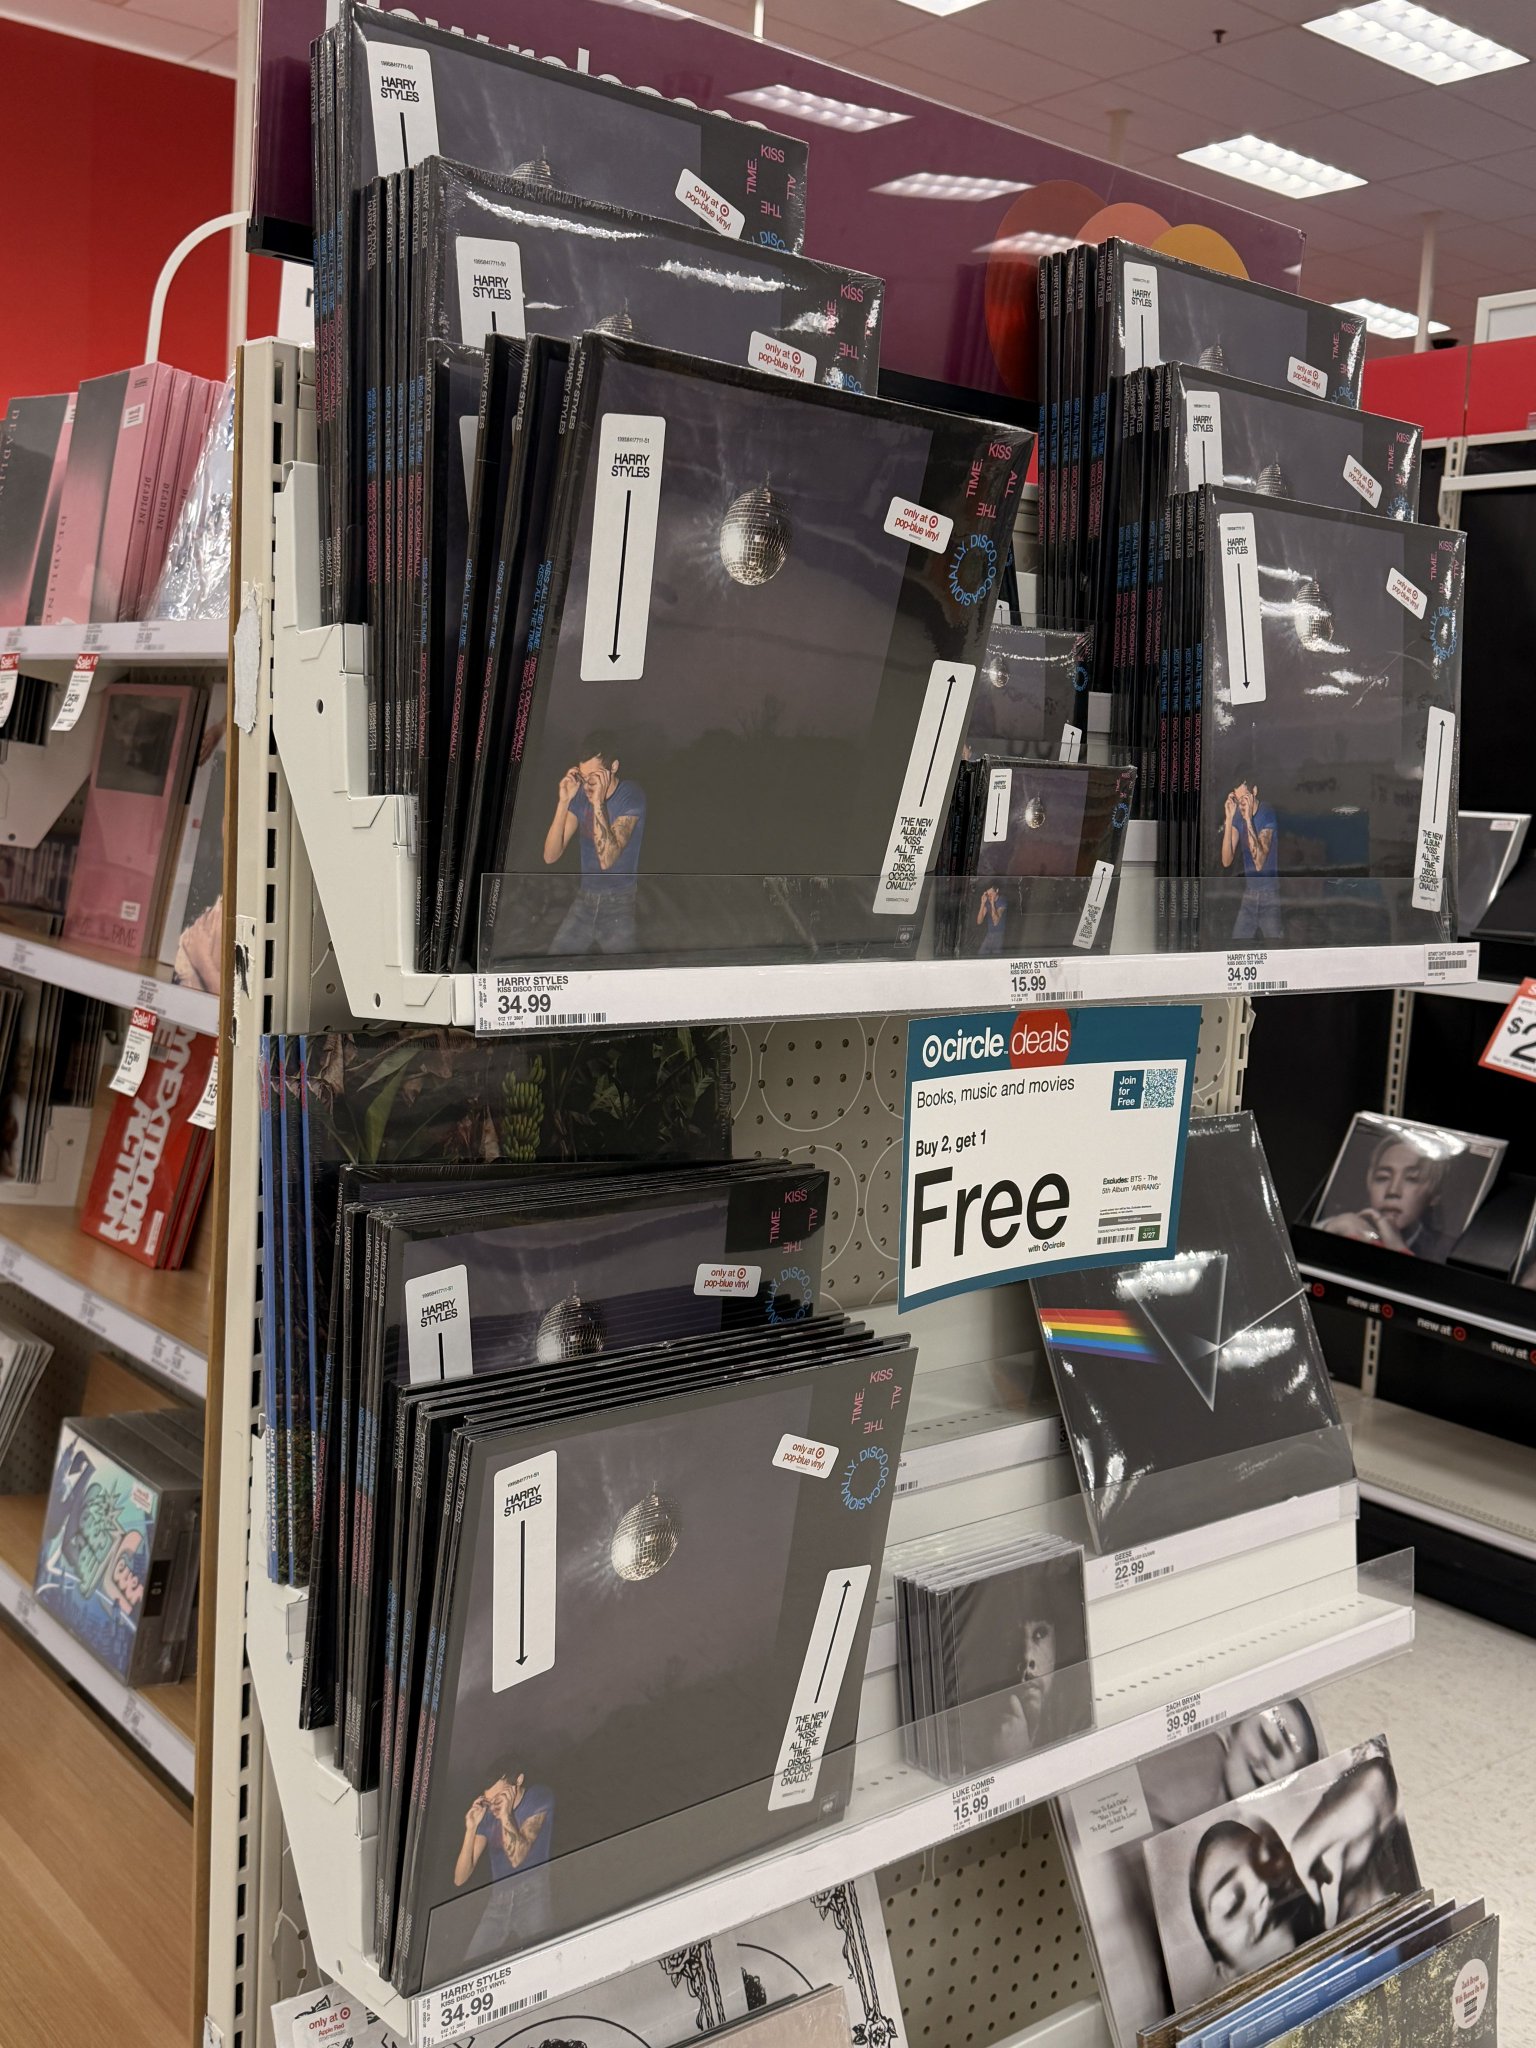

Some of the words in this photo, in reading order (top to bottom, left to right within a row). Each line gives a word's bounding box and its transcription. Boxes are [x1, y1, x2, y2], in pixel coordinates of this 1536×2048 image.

[381, 75, 416, 91] HARRY
[380, 88, 420, 102] STYLES
[760, 144, 784, 164] KISS
[746, 158, 758, 194] TIME.
[786, 174, 796, 200] ALL
[694, 184, 711, 203] only
[711, 198, 720, 209] at
[685, 190, 715, 218] pop-blue
[716, 214, 732, 230] vinyl
[760, 200, 782, 219] THE
[474, 274, 508, 288] HARRY
[472, 286, 512, 300] STYLES
[840, 284, 864, 302] KISS
[1132, 288, 1152, 298] HARRY
[1132, 296, 1152, 308] STYLES
[1340, 321, 1356, 334] KISS
[765, 342, 782, 356] only
[782, 350, 790, 359] at
[839, 342, 860, 360] THE
[483, 354, 491, 389] HARRY
[576, 352, 586, 388] HARRY
[758, 352, 789, 370] pop-blue
[790, 364, 805, 378] vinyl
[479, 390, 488, 429] STYLES
[568, 390, 580, 430] STYLES
[1192, 424, 1214, 433] STYLES
[1193, 415, 1212, 426] HARRY
[614, 453, 650, 466] HARRY
[988, 442, 1013, 460] KISS
[611, 465, 650, 478] STYLES
[966, 458, 984, 498] TIME.
[1004, 470, 1018, 498] ALL
[138, 476, 153, 526] DEADLINE
[156, 482, 170, 531] DEADLINE
[904, 506, 920, 522] only
[920, 514, 928, 524] at
[976, 502, 996, 519] THE
[894, 516, 924, 535] pop-blue
[924, 528, 940, 542] vinyl
[1226, 546, 1248, 556] STYLES
[1227, 538, 1247, 548] HARRY
[1438, 540, 1454, 552] KISS
[75, 655, 93, 670] Sale!
[900, 816, 915, 826] THE
[916, 818, 933, 828] NEW
[894, 845, 908, 854] ALL
[910, 846, 924, 854] THE
[1010, 962, 1032, 970] HARRY
[1034, 960, 1058, 969] STYLES
[1228, 966, 1257, 982] 34.99
[497, 977, 531, 986] HARRY
[534, 976, 568, 986] STYLES
[1012, 976, 1046, 992] 15.99
[498, 994, 552, 1014] 34.99
[132, 1010, 150, 1028] Sale!
[942, 1026, 1004, 1062] circle
[1011, 1022, 1070, 1056] deals
[1120, 1076, 1136, 1085] Join
[917, 1088, 957, 1108] Books,
[961, 1082, 998, 1102] music
[1001, 1079, 1026, 1096] and
[1028, 1076, 1075, 1094] movies
[1118, 1086, 1130, 1096] for
[1118, 1097, 1136, 1106] Free
[916, 1138, 938, 1158] Buy
[942, 1135, 952, 1154] 2,
[956, 1132, 976, 1152] get
[980, 1129, 986, 1145] 1
[1102, 1177, 1129, 1186] Excludes:
[784, 1188, 808, 1204] KISS
[770, 1207, 780, 1244] TIME.
[808, 1208, 818, 1232] ALL
[912, 1166, 1070, 1269] Free
[782, 1240, 804, 1254] THE
[1028, 1244, 1040, 1252] with
[1048, 1240, 1066, 1250] circle
[710, 1268, 726, 1278] only
[728, 1269, 736, 1278] at
[704, 1279, 734, 1289] pop-blue
[734, 1280, 750, 1290] vinyl
[421, 1298, 456, 1318] HARRY
[420, 1308, 458, 1328] STYLES
[1417, 1317, 1440, 1332] new
[1440, 1325, 1452, 1336] at
[870, 1368, 894, 1384] KISS
[852, 1388, 866, 1424] TIME.
[890, 1385, 902, 1410] ALL
[863, 1418, 884, 1434] THE
[792, 1442, 806, 1454] only
[807, 1446, 815, 1454] at
[782, 1452, 810, 1466] pop-blue
[810, 1458, 826, 1471] vinyl
[506, 1484, 541, 1506] HARRY
[504, 1494, 542, 1518] STYLES
[1114, 1550, 1132, 1561] GEESE
[1115, 1560, 1144, 1580] 22.99
[1166, 1701, 1180, 1712] ZACH
[1182, 1692, 1200, 1706] BRYAN
[795, 1714, 810, 1724] THE
[810, 1710, 829, 1720] NEW
[1167, 1709, 1196, 1732] 39.99
[789, 1741, 802, 1751] ALL
[805, 1736, 820, 1746] THE
[952, 1786, 970, 1800] LUKE
[971, 1776, 995, 1792] COMBS
[954, 1795, 988, 1820] 15.99
[440, 1980, 475, 2001] HARRY
[476, 1966, 512, 1988] STYLES
[440, 1998, 456, 2008] KISS
[456, 1991, 476, 2003] DISCO
[476, 1986, 488, 1994] TGT
[490, 1980, 506, 1990] VINYL
[441, 1992, 494, 2026] 34.99
[309, 2017, 328, 2030] only
[330, 2012, 338, 2022] at
[334, 2022, 344, 2032] Red
